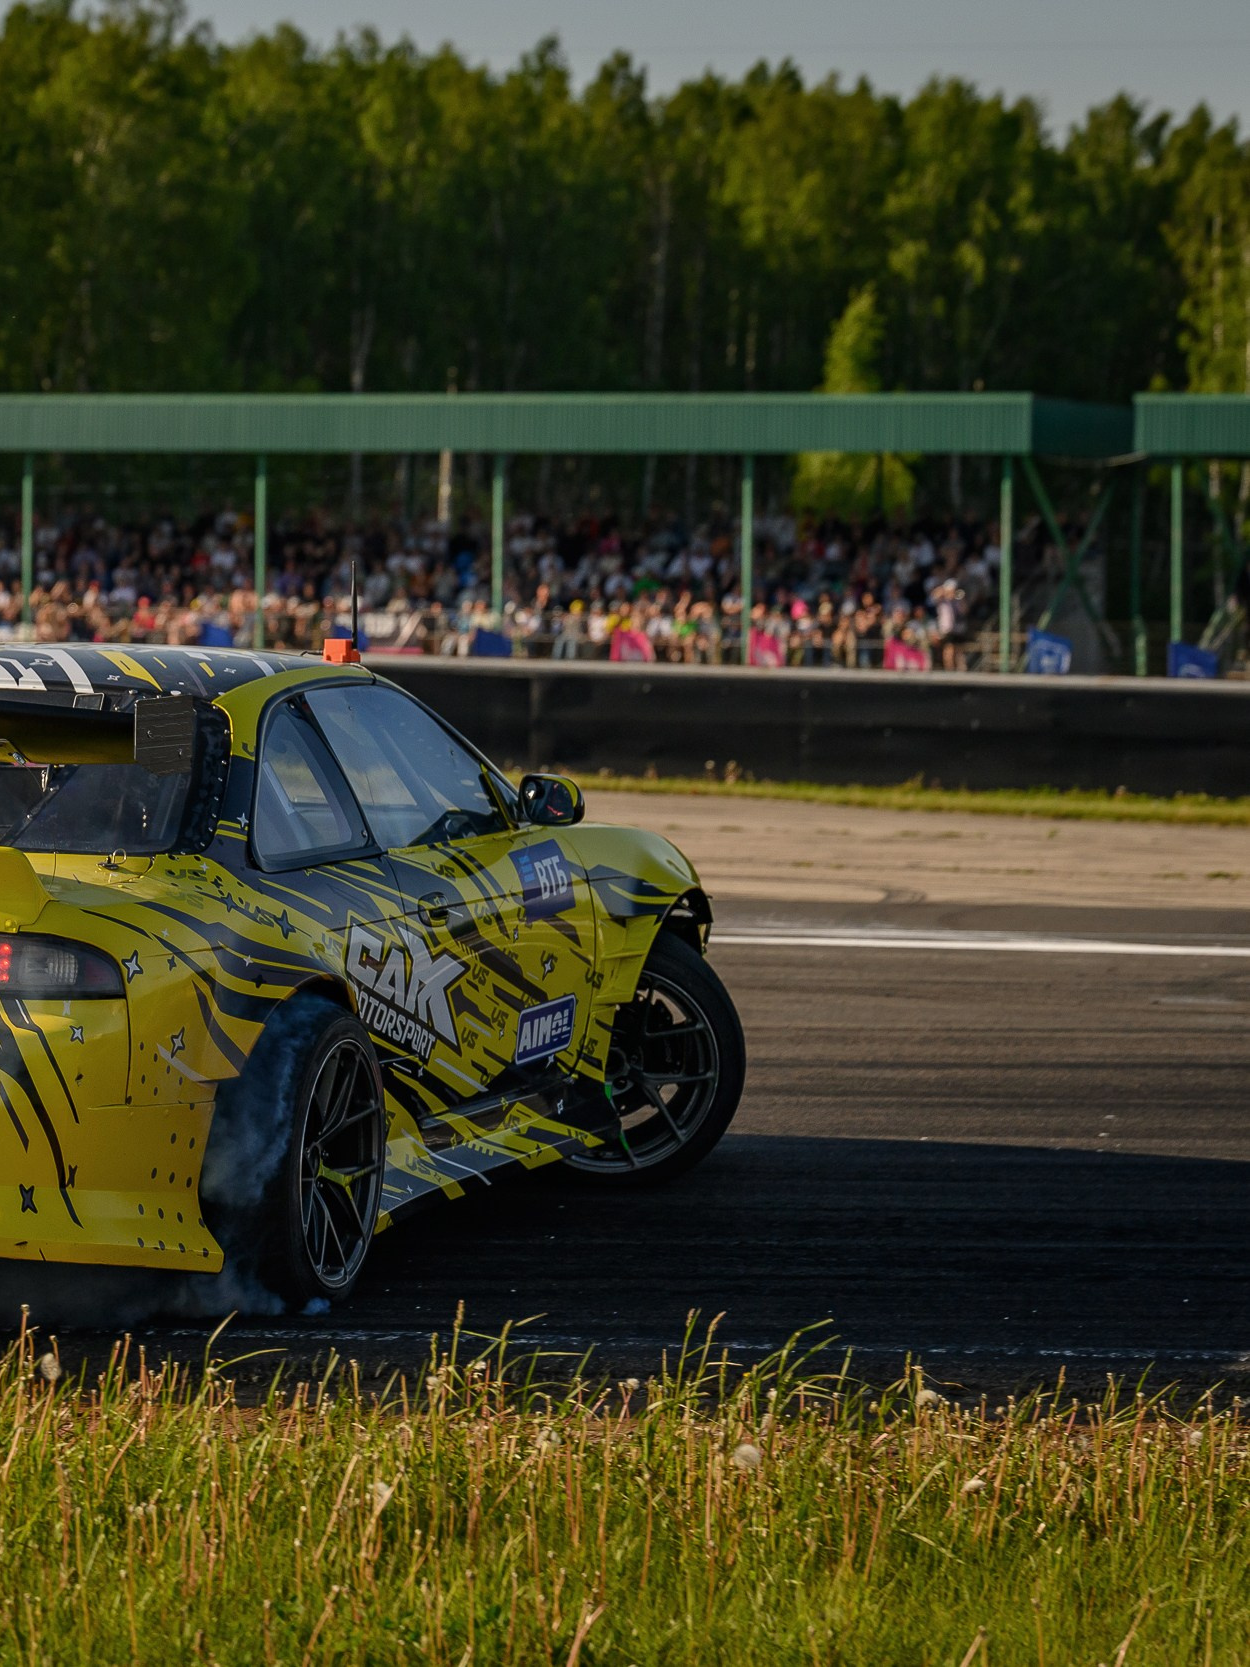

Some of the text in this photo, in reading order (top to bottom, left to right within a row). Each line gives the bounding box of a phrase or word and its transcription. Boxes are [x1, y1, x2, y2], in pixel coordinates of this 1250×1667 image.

[533, 855, 568, 900] ВТБ
[472, 963, 490, 986] US
[490, 1006, 509, 1029] US
[461, 1027, 479, 1049] US
